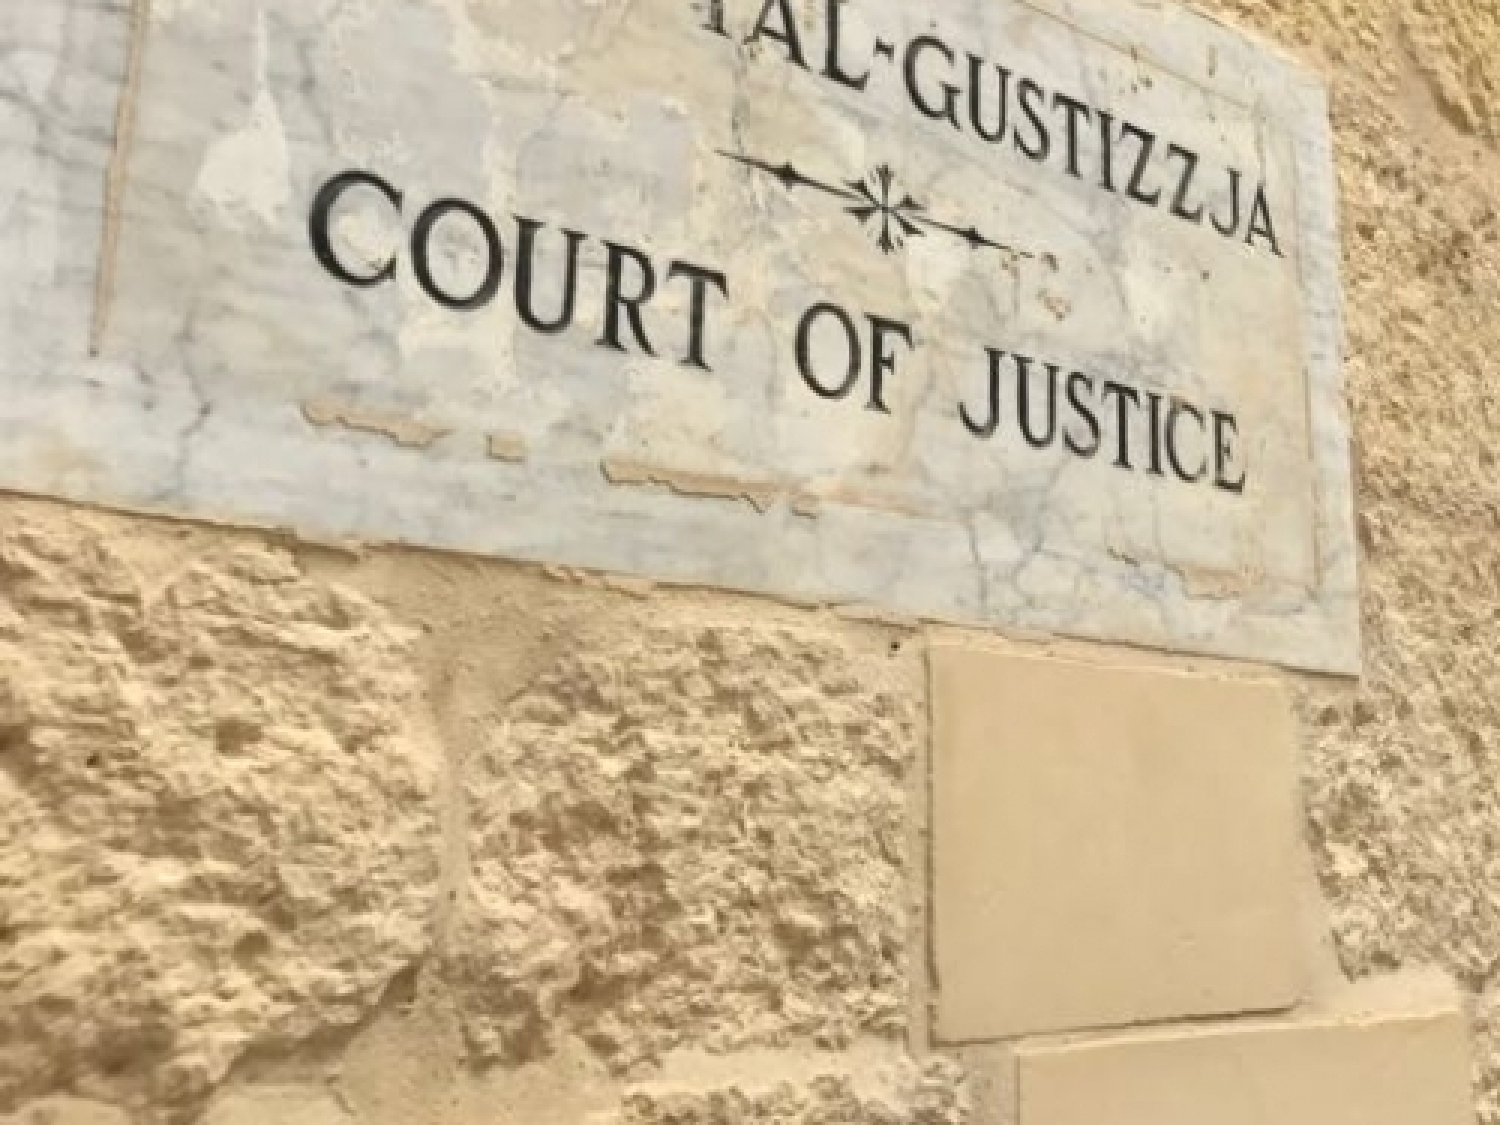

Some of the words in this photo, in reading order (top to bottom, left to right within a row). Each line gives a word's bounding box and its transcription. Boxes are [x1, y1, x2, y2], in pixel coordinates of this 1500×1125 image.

[308, 170, 728, 372] COURT
[794, 301, 915, 414] OF
[957, 344, 1247, 495] JUSTICE
